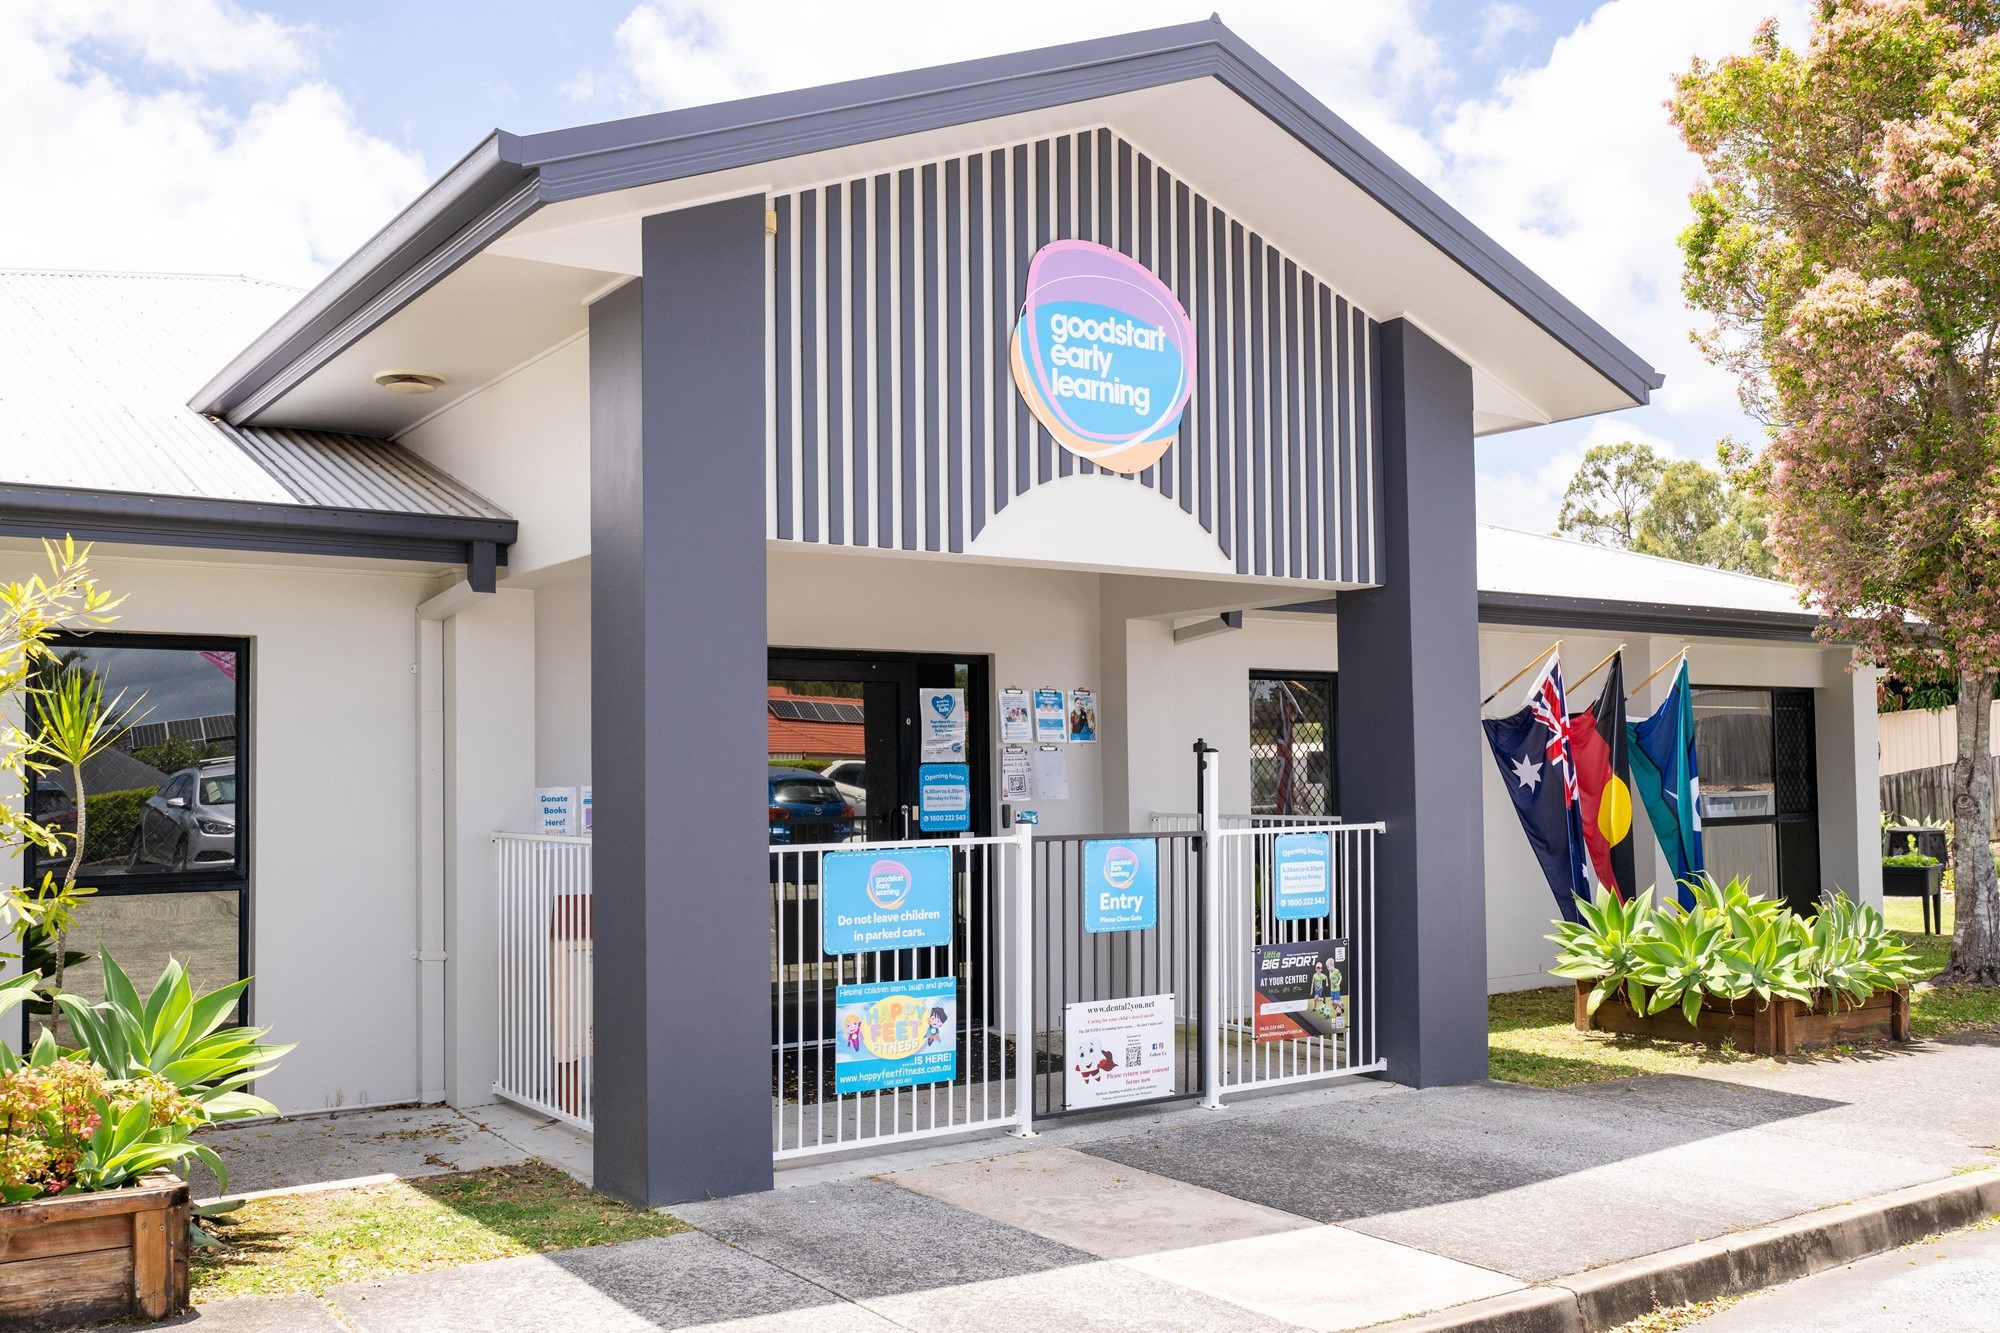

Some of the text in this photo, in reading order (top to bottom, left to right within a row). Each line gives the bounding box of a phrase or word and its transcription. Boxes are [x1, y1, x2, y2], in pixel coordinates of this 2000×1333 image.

[1051, 313, 1166, 352] goodstart
[1051, 344, 1113, 378] early
[1052, 368, 1150, 416] learning
[925, 773, 964, 781] Opening hours
[1282, 846, 1323, 857] Opening hours
[876, 875, 903, 884] goodstart
[1100, 893, 1143, 912] Entry
[838, 909, 940, 926] Do not leave children
[854, 927, 925, 943] in parked cars.
[1261, 955, 1318, 970] BIG SPORT
[1264, 951, 1281, 959] Little
[1260, 974, 1308, 987] AT YOUR CENTRE!
[840, 988, 862, 997] Helping
[909, 983, 924, 991] laugh
[866, 1002, 925, 1025] HAPPY
[1087, 1001, 1155, 1014] www.dental2you.net
[870, 1021, 922, 1042] FEET
[871, 1039, 919, 1054] FITNESS
[926, 1053, 952, 1063] HERE!
[840, 1065, 952, 1083] www.happyfeetfitness.com.au
